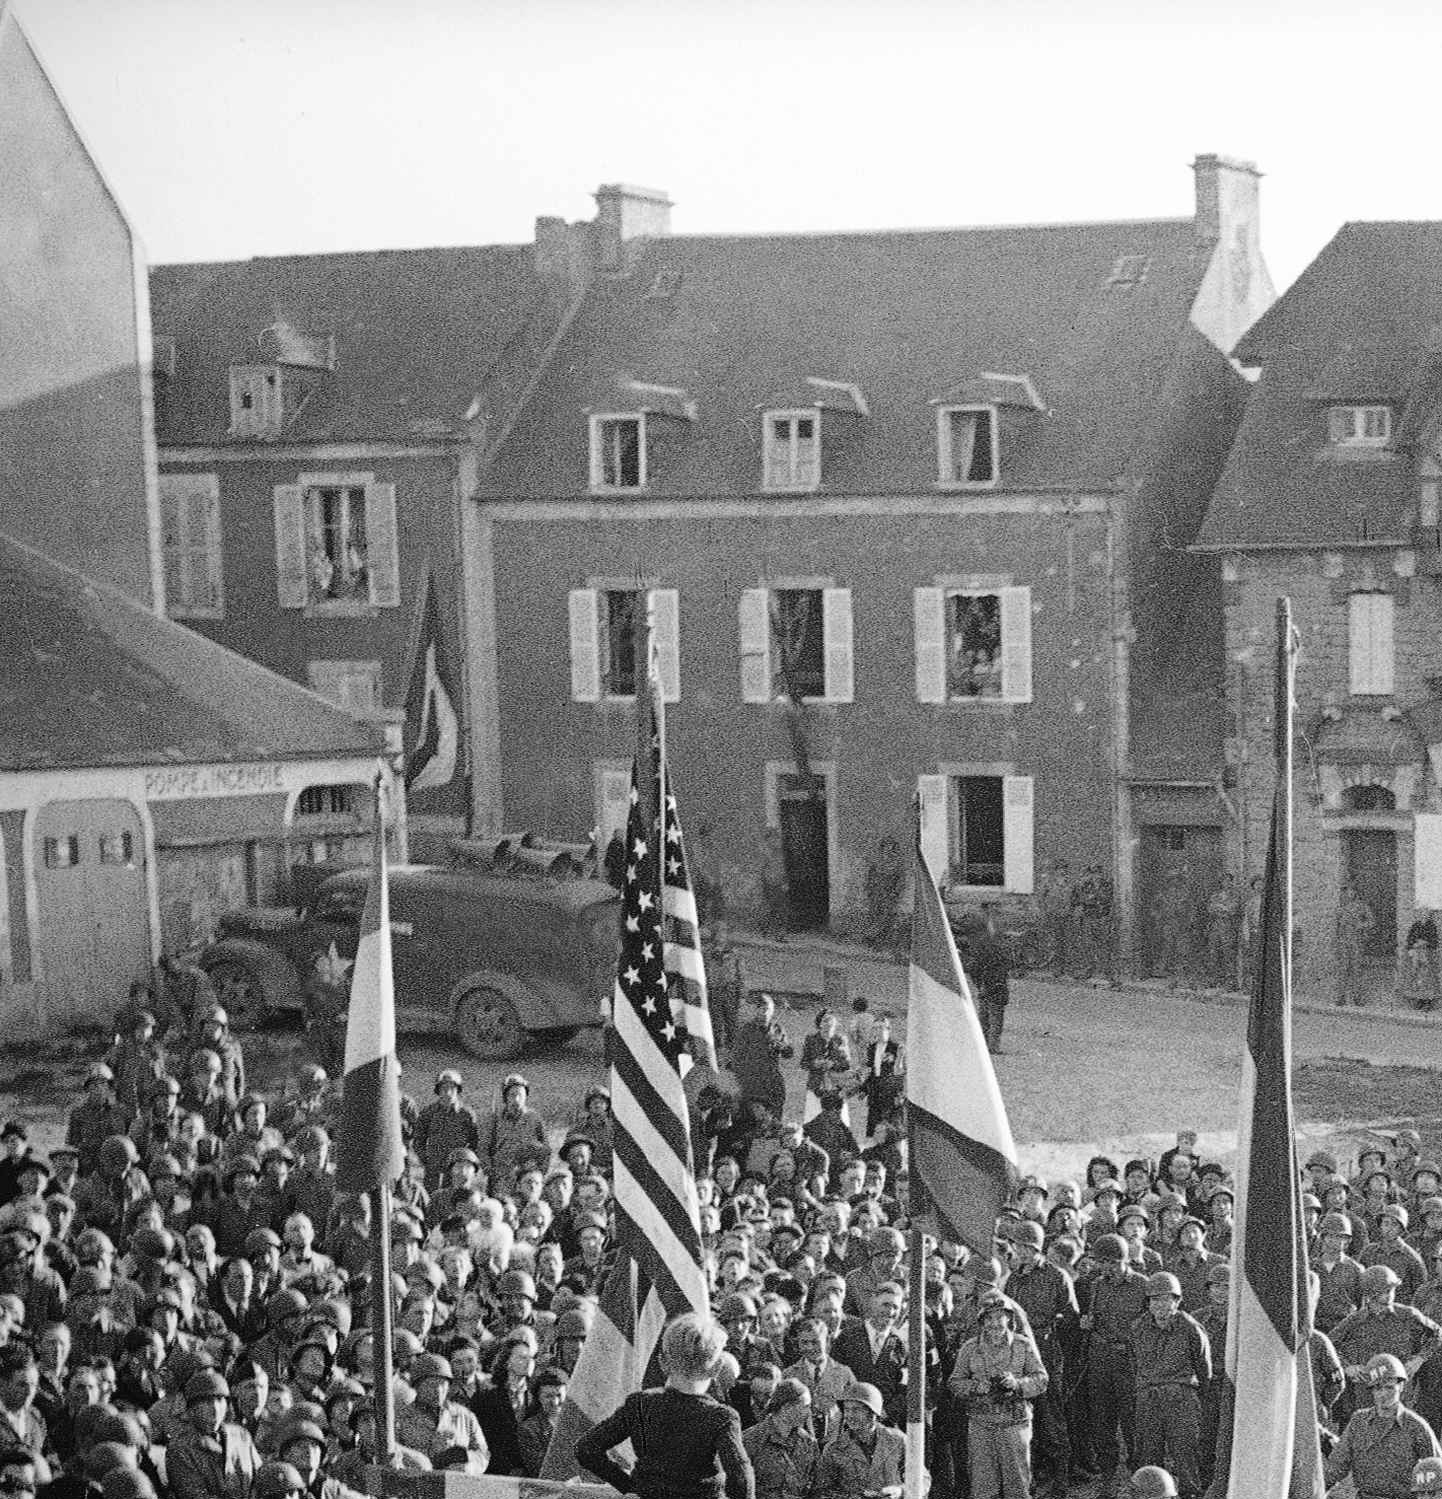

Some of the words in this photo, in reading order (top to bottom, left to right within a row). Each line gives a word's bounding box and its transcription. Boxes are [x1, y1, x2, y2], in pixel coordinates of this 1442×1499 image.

[145, 770, 198, 795] POMPE
[211, 765, 283, 790] INCENDIE
[1370, 1365, 1387, 1381] MP
[1416, 1471, 1436, 1484] MP
